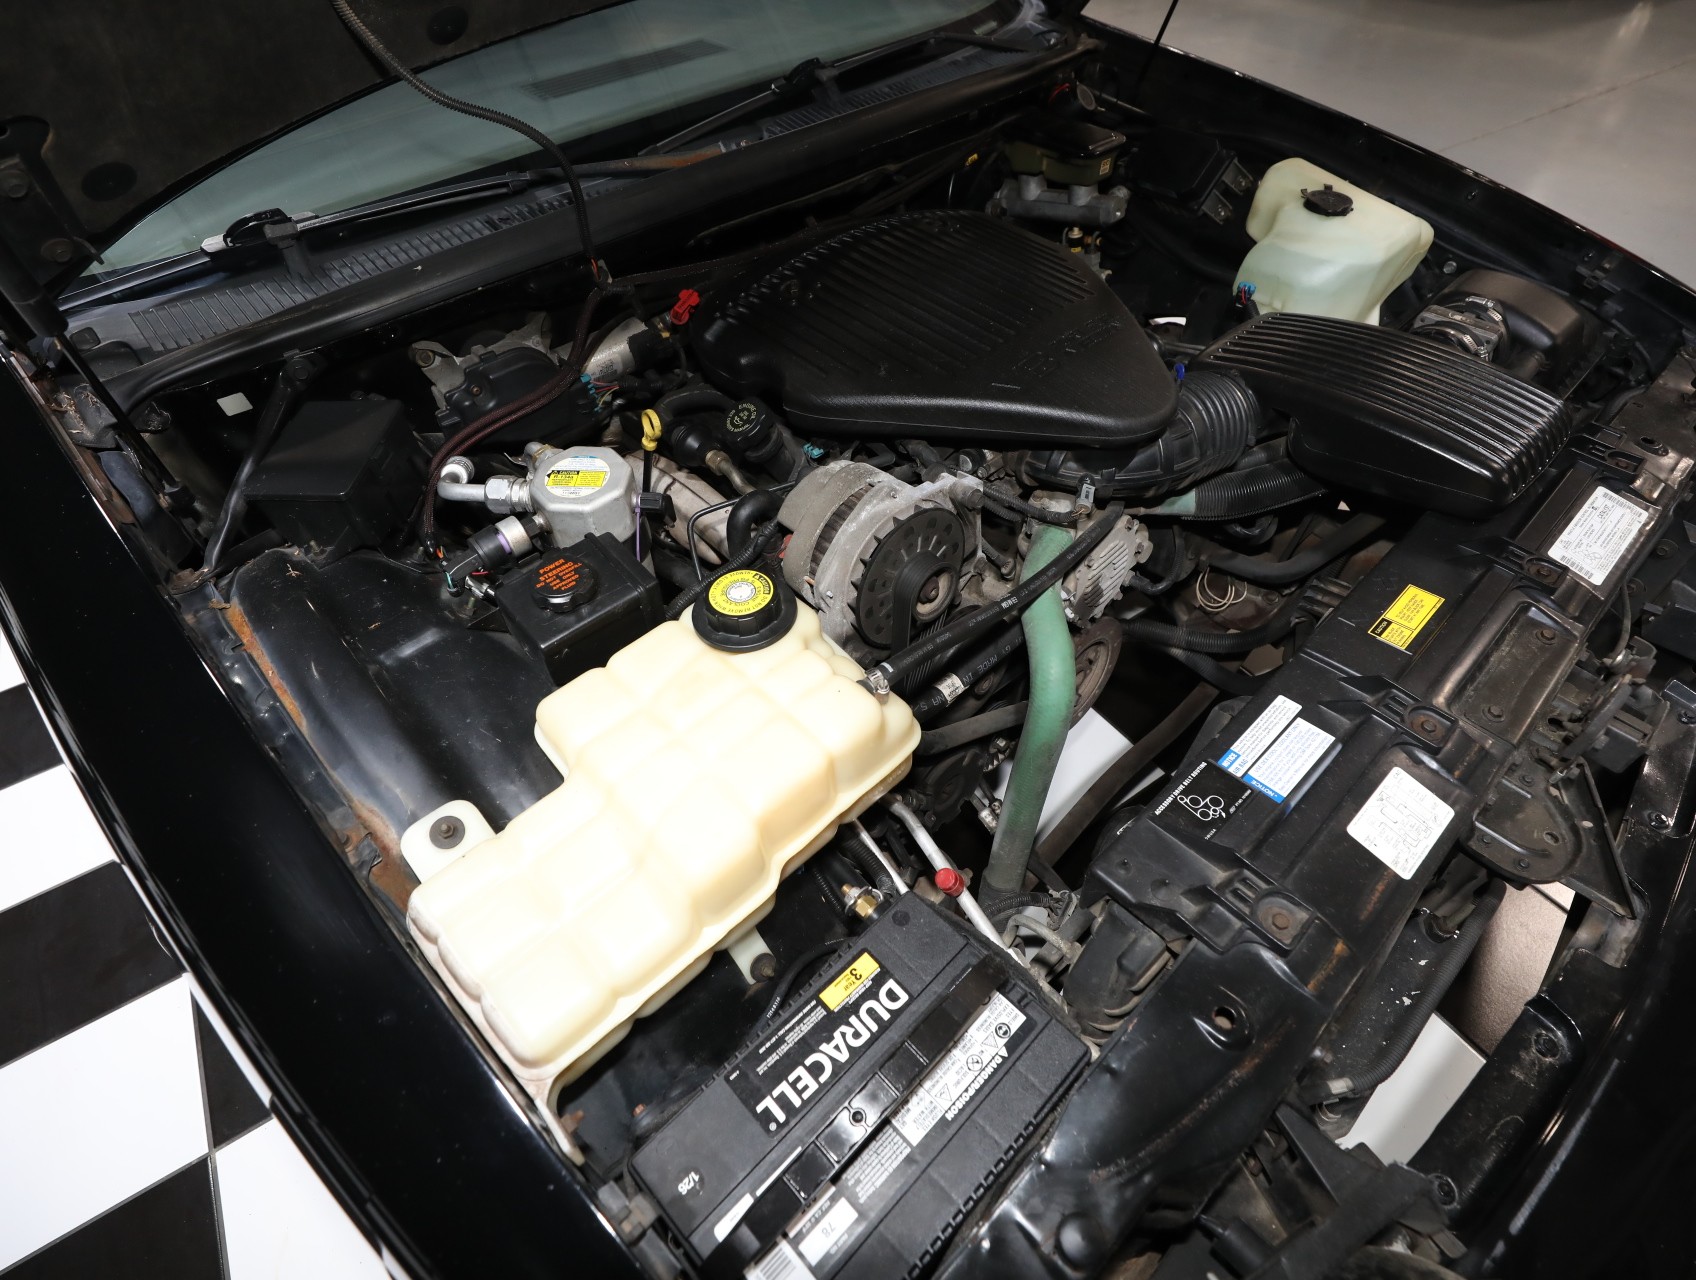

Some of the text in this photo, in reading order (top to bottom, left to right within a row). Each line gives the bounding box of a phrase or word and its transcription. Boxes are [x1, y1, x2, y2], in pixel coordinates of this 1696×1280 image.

[538, 557, 565, 574] POWER
[538, 560, 573, 581] STEERING
[545, 575, 556, 583] NOT
[558, 561, 582, 576] OVERFILL
[549, 570, 575, 586] USE ONLY
[552, 573, 579, 590] APPROVED
[560, 580, 576, 590] FLUID
[758, 576, 769, 593] CAUTION
[961, 654, 999, 683] MADE IN
[1221, 751, 1237, 767] NOTICE
[1153, 760, 1207, 815] ACCESSORY DRIVE BELT ROUTING
[1250, 779, 1274, 797] NOTICE
[842, 966, 863, 992] 3 Year
[755, 979, 908, 1125] DURACELL
[943, 1053, 1003, 1121] DANGER/POISON
[677, 1171, 699, 1195] 1/26
[821, 1222, 835, 1237] 78
